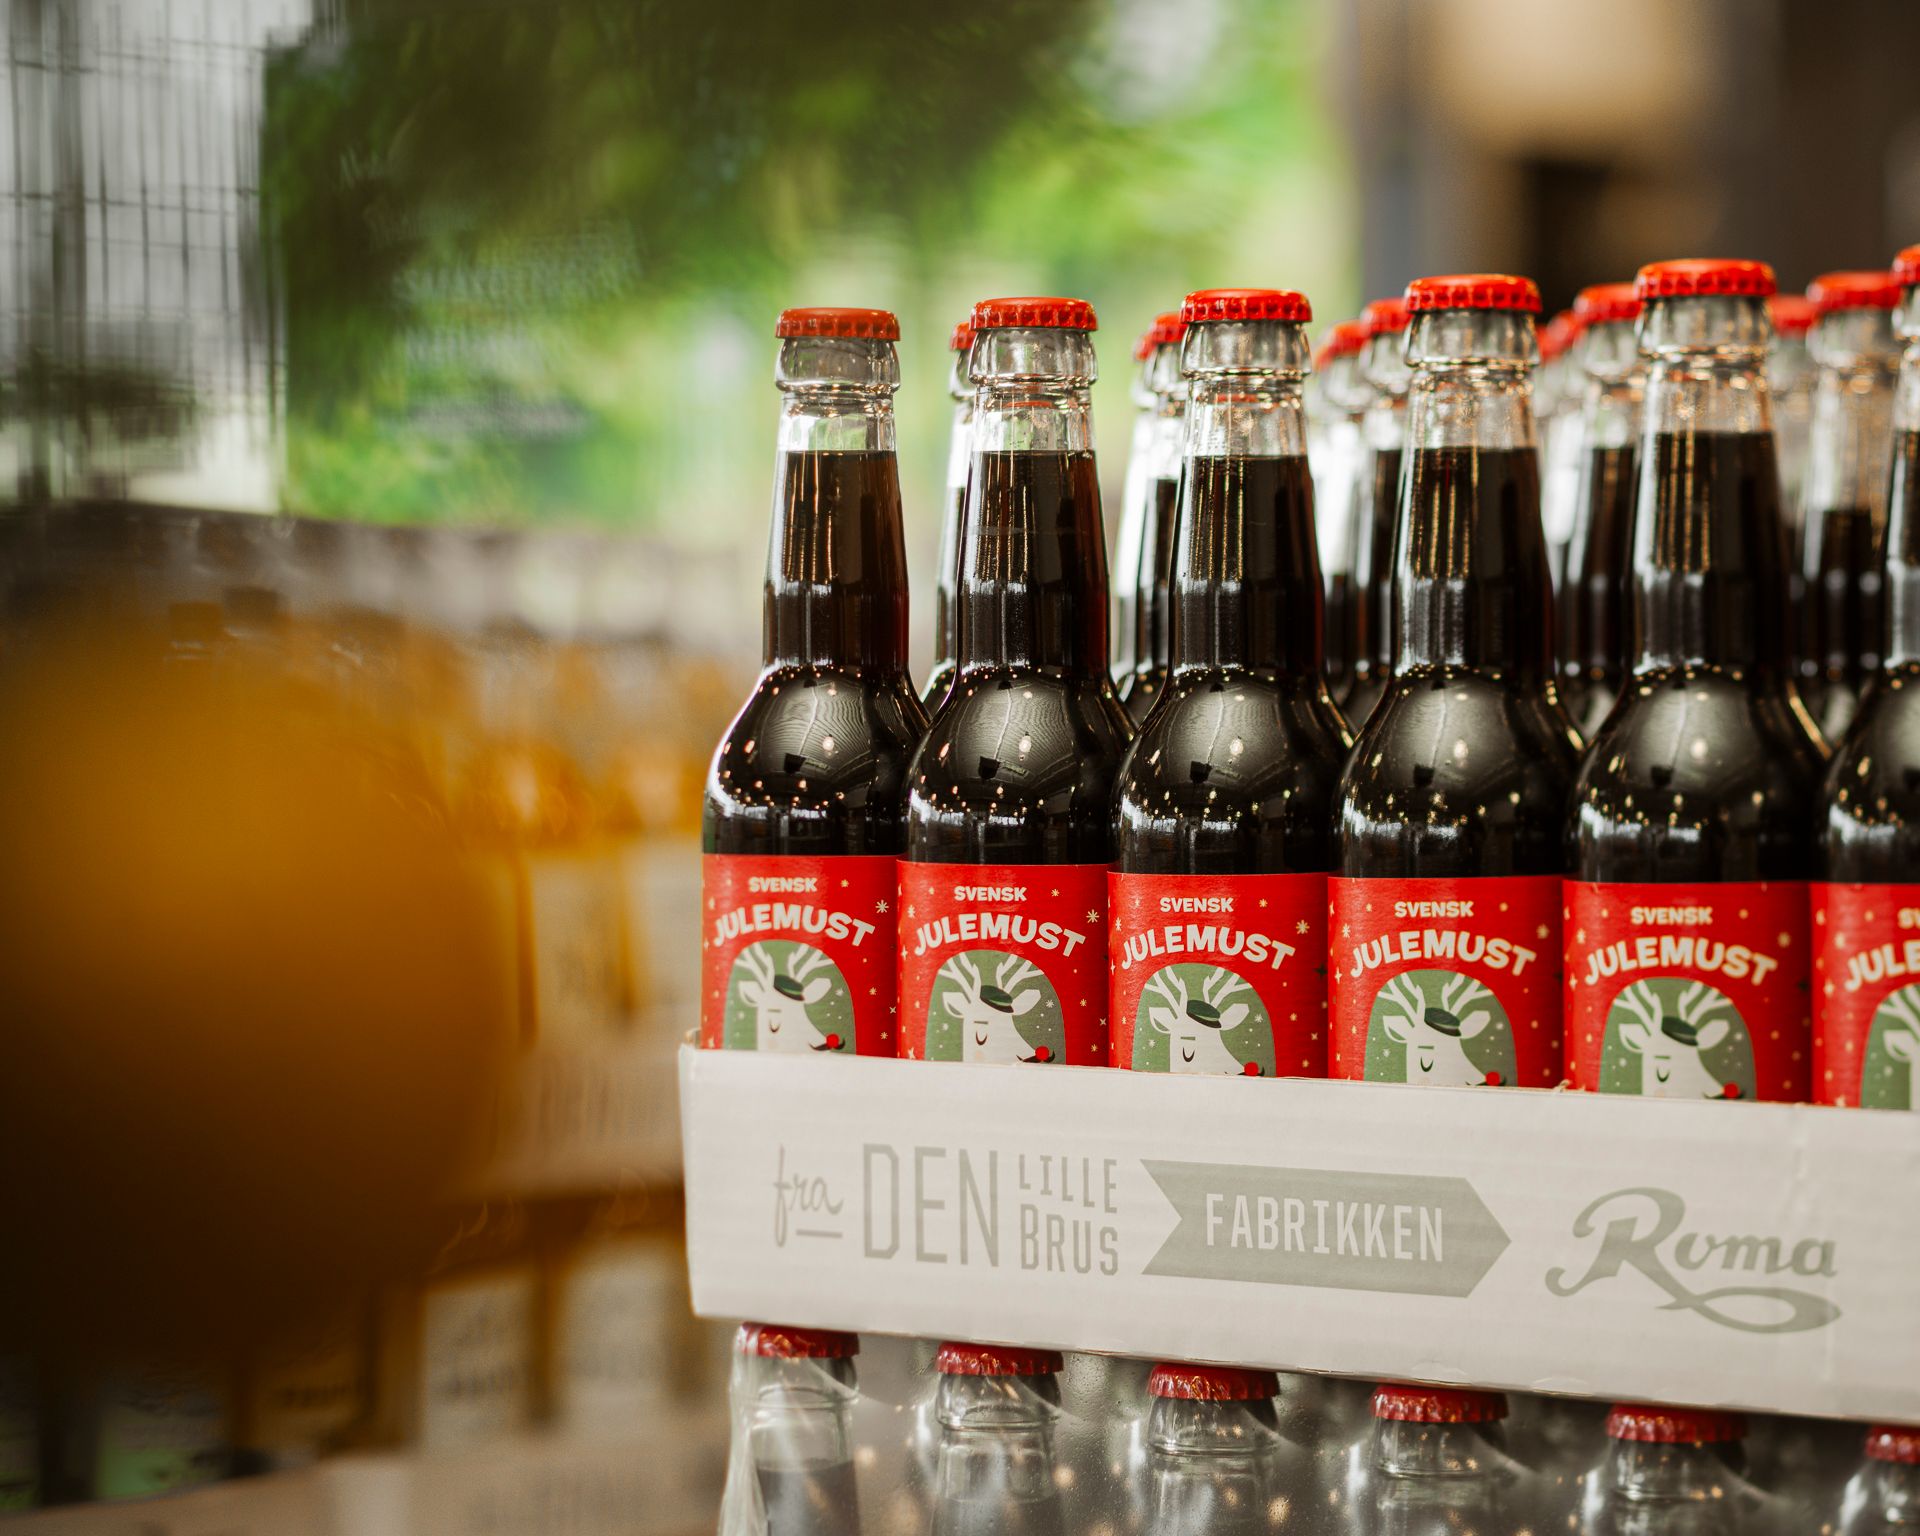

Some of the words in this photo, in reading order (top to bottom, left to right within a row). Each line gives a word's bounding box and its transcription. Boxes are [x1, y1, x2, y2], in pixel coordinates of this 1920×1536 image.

[748, 877, 818, 893] SVENSK
[953, 886, 1028, 902] SVENSK
[1159, 897, 1234, 913] SVENSK
[713, 903, 876, 948] JULEMUST
[1394, 901, 1474, 918] SVENSK
[1630, 906, 1714, 926] SVENSK
[914, 912, 1087, 958] JULEMUST
[1121, 924, 1296, 971] JULEMUST
[1350, 929, 1537, 977] JULEMUST
[1585, 935, 1778, 986] JULEMUST
[1844, 938, 1920, 992] JULE
[772, 1143, 844, 1248] fra
[863, 1142, 999, 1268] DEN
[1018, 1153, 1119, 1214] LILLE
[1020, 1203, 1120, 1277] BRUS
[1205, 1192, 1444, 1264] FABRIKKEN
[1545, 1186, 1842, 1334] Roma
